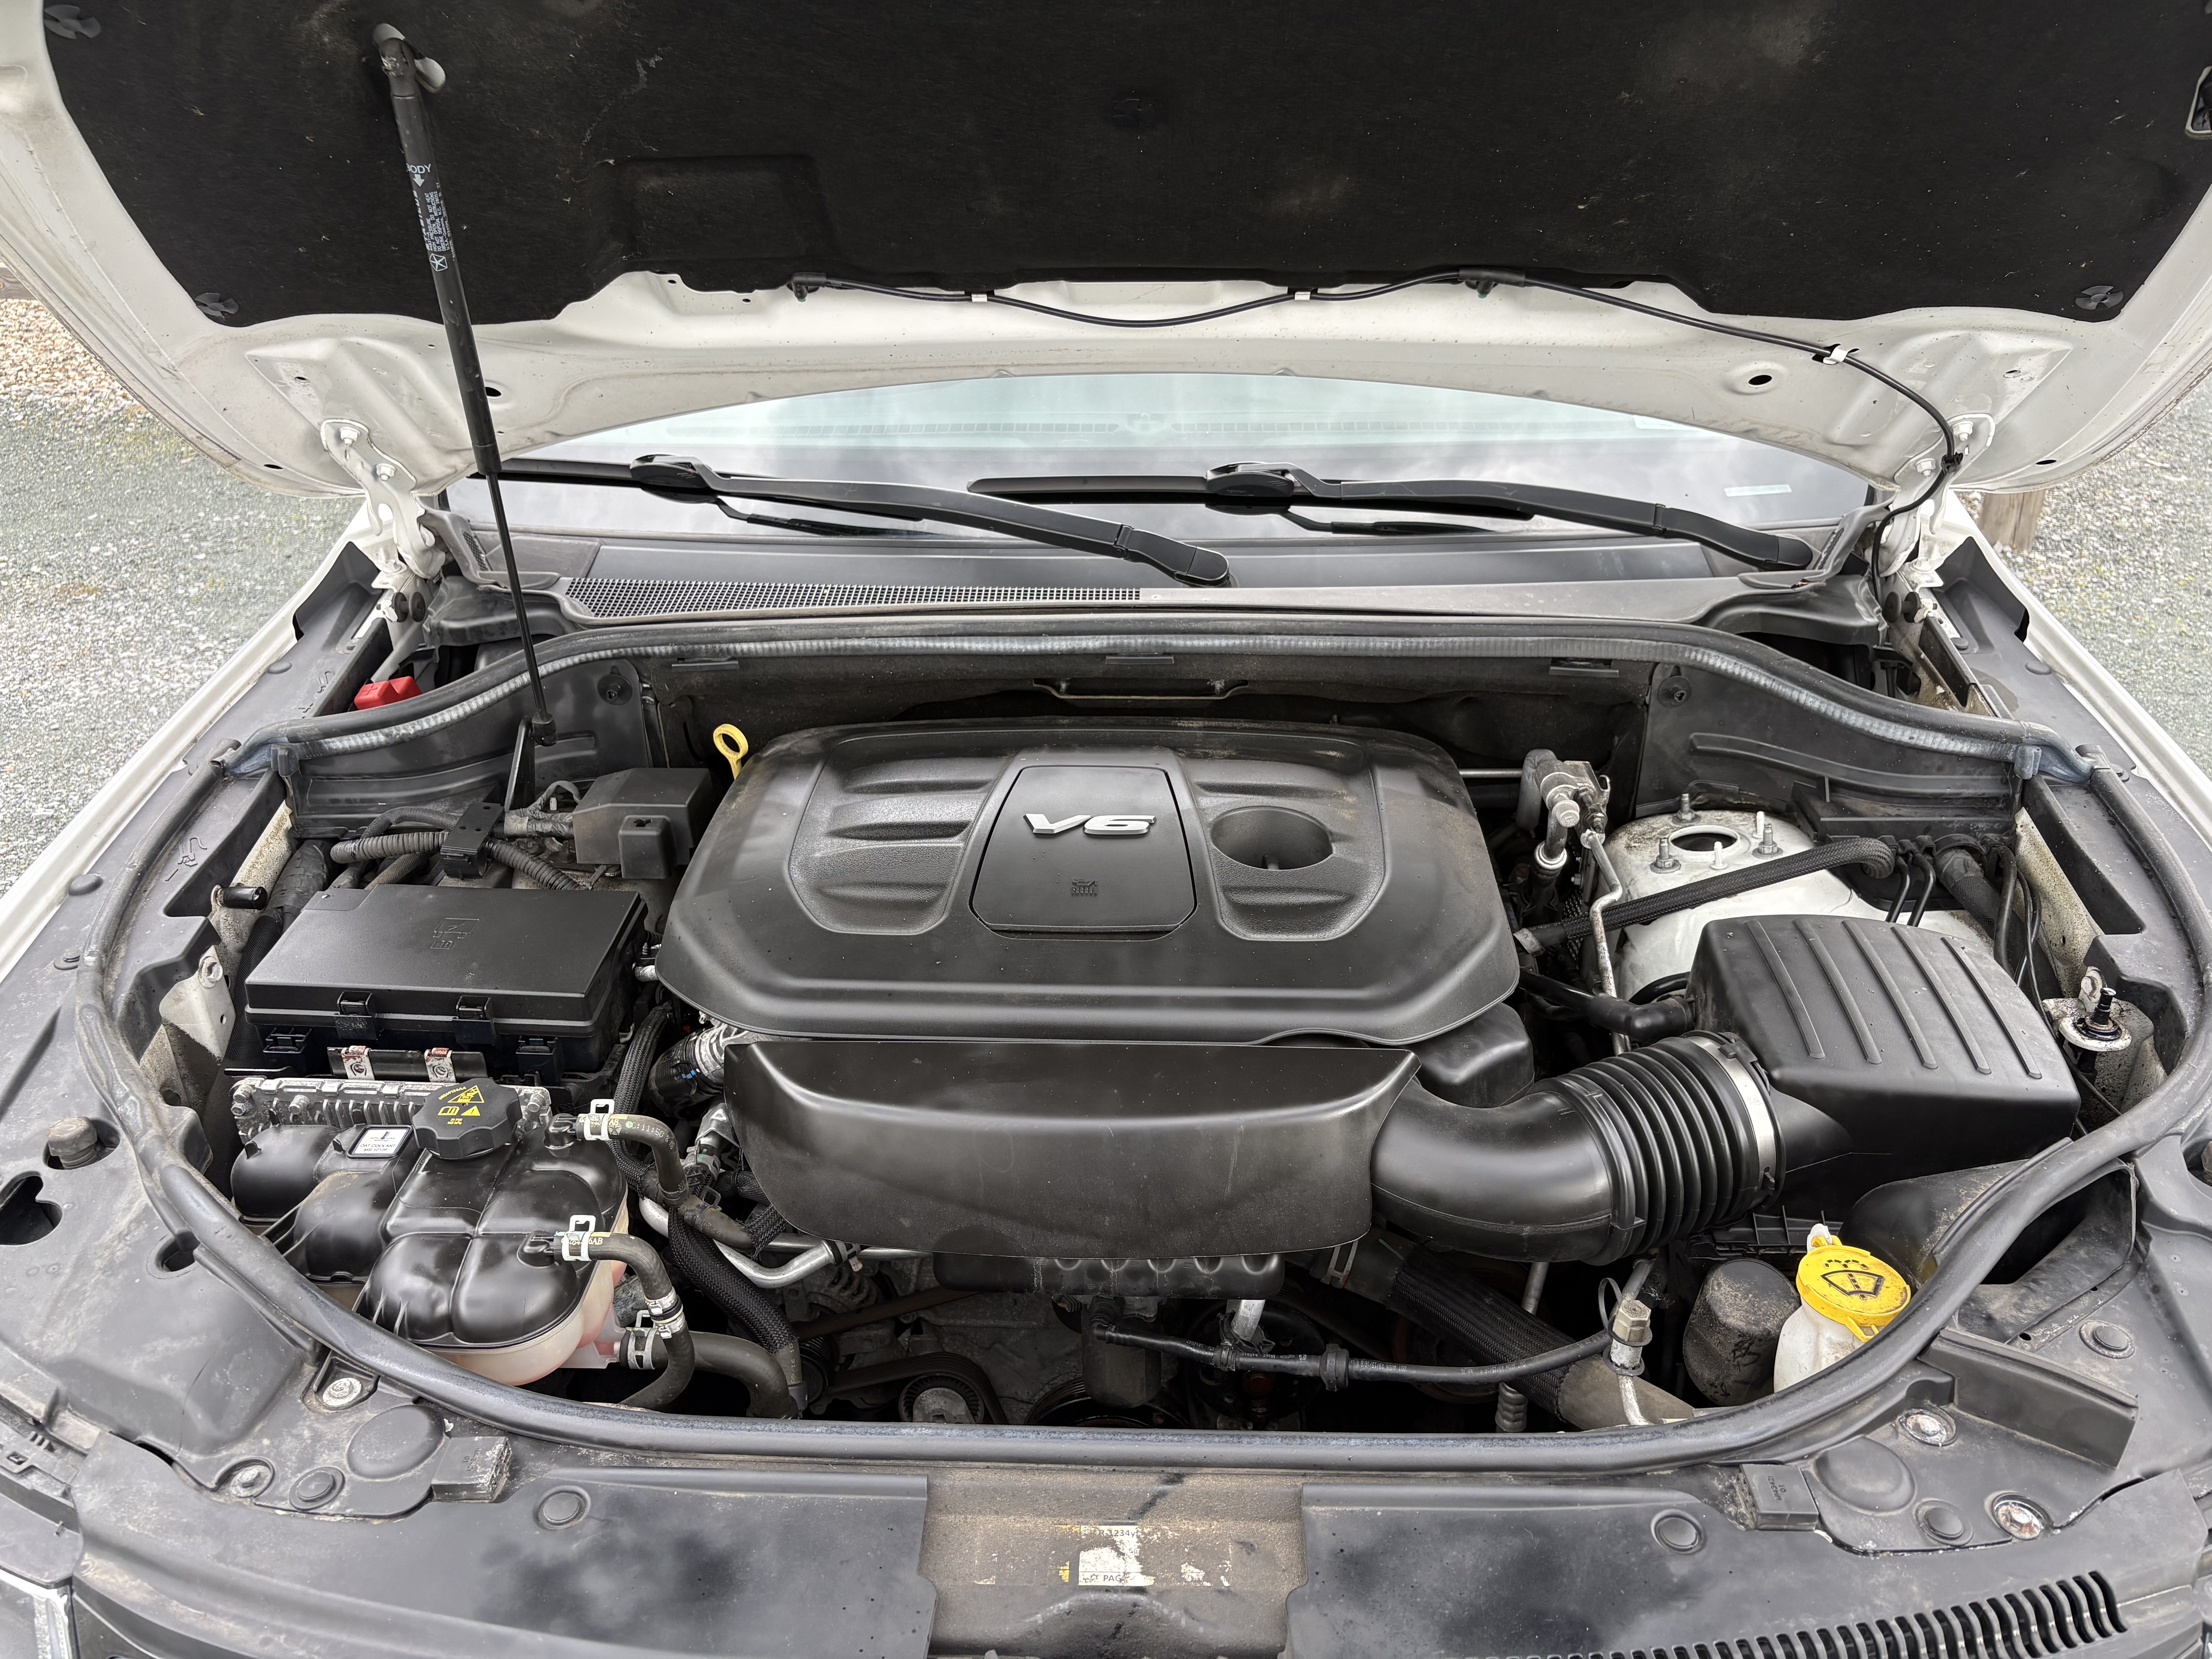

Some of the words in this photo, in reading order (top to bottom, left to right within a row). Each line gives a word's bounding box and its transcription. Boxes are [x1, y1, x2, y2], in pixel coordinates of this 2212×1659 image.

[429, 192, 438, 216] INSTRUCTIONS
[426, 218, 434, 240] PRESSURE
[1023, 814, 1157, 835] V6
